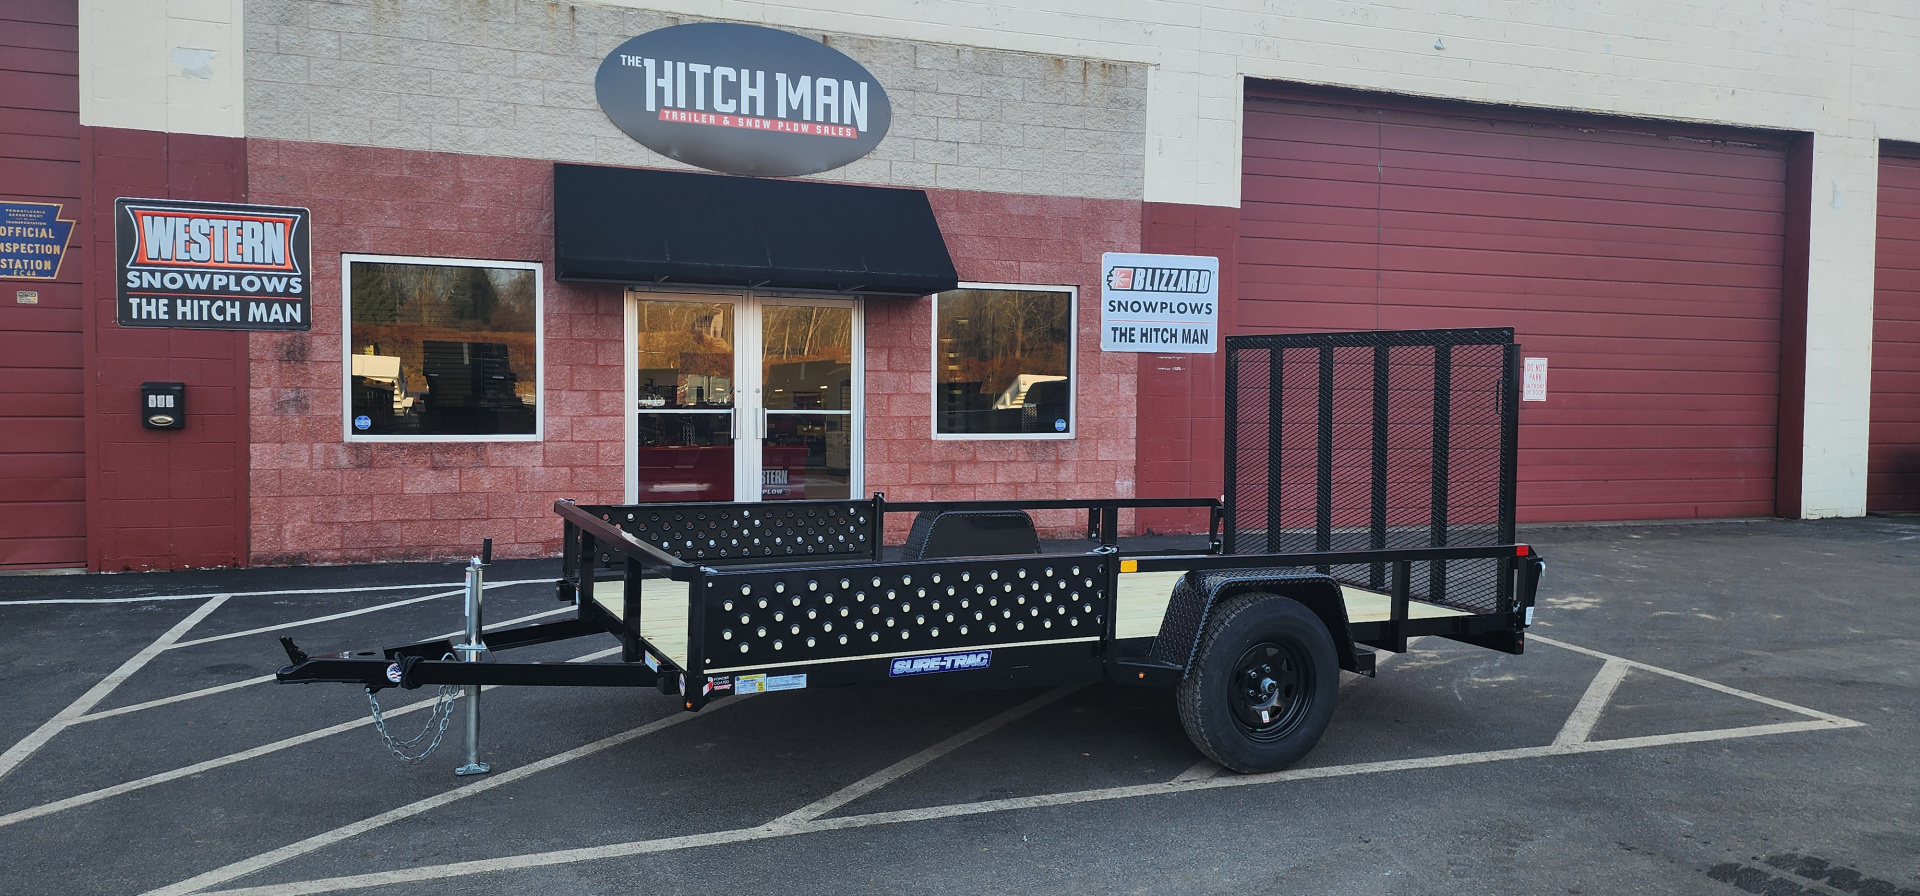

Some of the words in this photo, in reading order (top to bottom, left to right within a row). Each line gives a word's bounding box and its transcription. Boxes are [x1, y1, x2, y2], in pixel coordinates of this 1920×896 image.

[620, 54, 642, 68] THE
[643, 58, 765, 117] HITCH
[775, 72, 868, 132] MAN
[664, 110, 716, 124] TRAILER
[723, 116, 730, 125] &
[738, 117, 771, 129] SNOW
[778, 121, 809, 133] PLOW
[816, 125, 852, 137] SALES
[0, 226, 55, 239] OFFICIAL
[142, 215, 286, 264] WESTERN
[0, 242, 60, 255] NSPECTION
[0, 258, 51, 271] STATION
[126, 271, 302, 294] SNOWPLOWS
[1133, 268, 1210, 293] BLIZZARD
[128, 297, 169, 320] THE
[176, 299, 240, 322] HITCH
[247, 302, 302, 323] MAN
[1108, 300, 1213, 315] SNOWPLOWS
[1111, 327, 1136, 343] THE
[1140, 327, 1178, 344] HITCH
[1182, 328, 1208, 344] MAN
[1527, 363, 1534, 371] DO
[1535, 363, 1545, 371] NOT
[1529, 373, 1542, 381] PARK
[762, 469, 788, 484] STERN
[892, 653, 989, 675] SURE-TRAC
